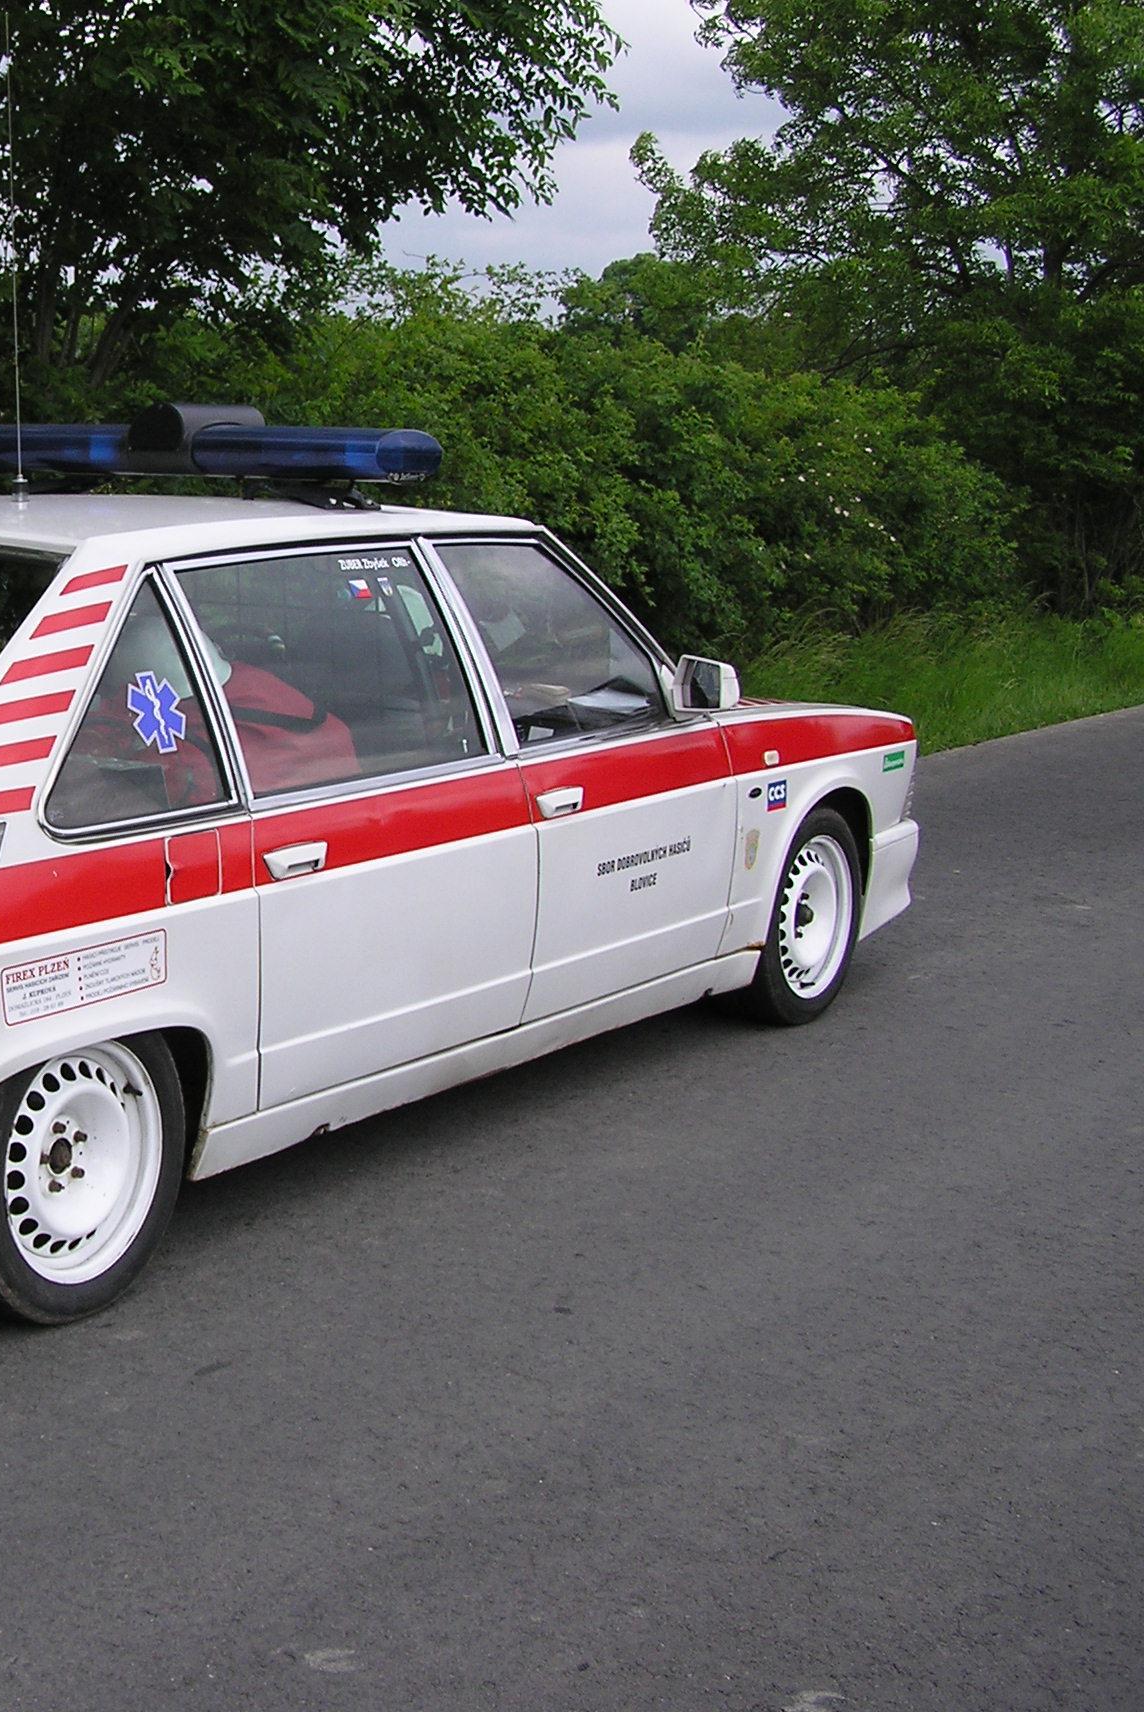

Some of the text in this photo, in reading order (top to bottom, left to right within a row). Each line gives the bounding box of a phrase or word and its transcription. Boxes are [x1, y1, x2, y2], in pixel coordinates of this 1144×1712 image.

[768, 784, 785, 801] CCS
[597, 860, 616, 876] SBOR
[630, 872, 657, 892] BLOVICE
[5, 968, 35, 985] FIREX
